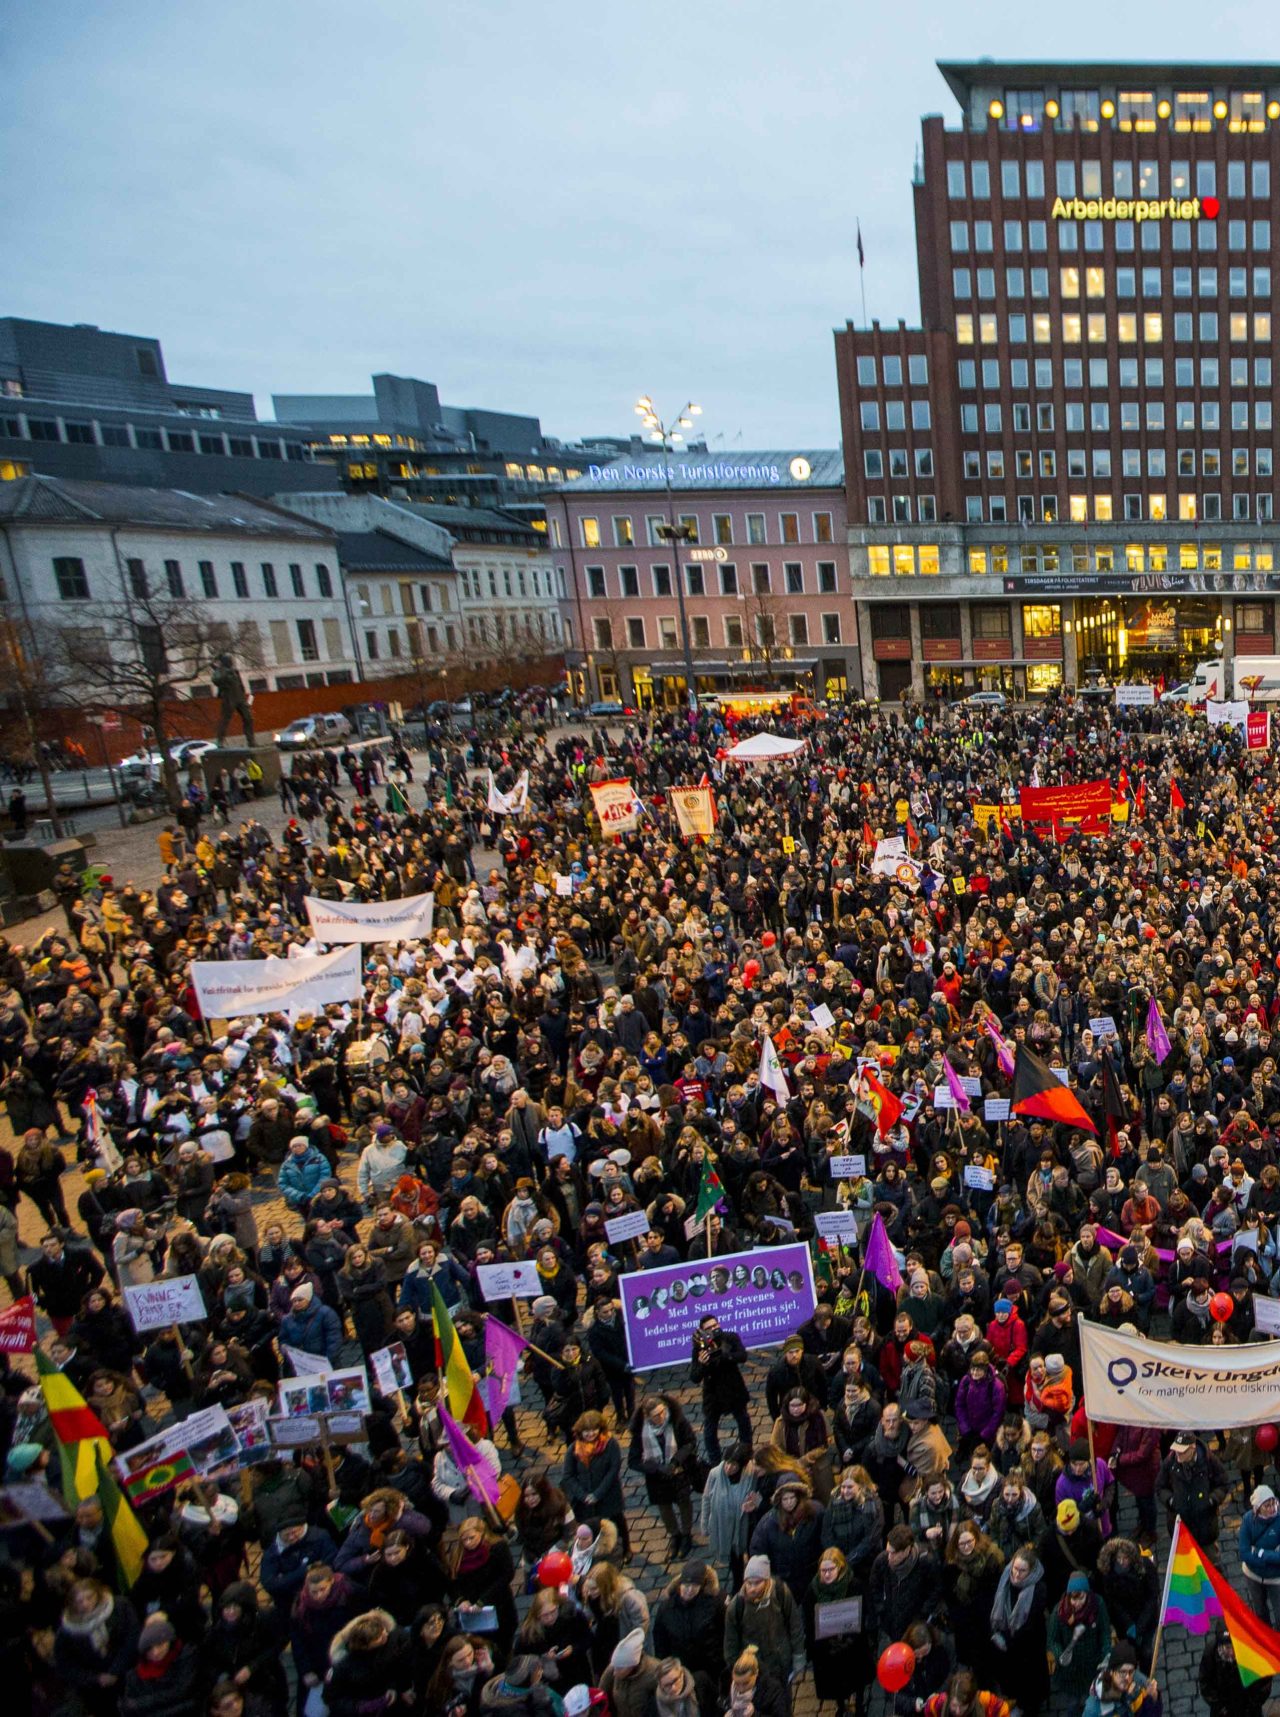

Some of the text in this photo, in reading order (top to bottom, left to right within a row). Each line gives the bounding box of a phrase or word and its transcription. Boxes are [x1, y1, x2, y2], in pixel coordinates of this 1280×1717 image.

[1052, 196, 1200, 223] Arbeiderpartiet
[589, 464, 780, 482] Den Norske Turistforening
[668, 1291, 775, 1319] Med Sara og Sevenes
[644, 1323, 679, 1338] ledelse
[734, 1304, 777, 1321] frihetens
[779, 1300, 800, 1316] sjel,
[740, 1323, 750, 1332] et
[752, 1317, 772, 1331] fritt
[774, 1314, 790, 1328] liv!
[1141, 1361, 1209, 1380] Skeiv
[1138, 1384, 1152, 1396] for
[1156, 1383, 1206, 1398] mangfold
[1215, 1383, 1238, 1394] mot
